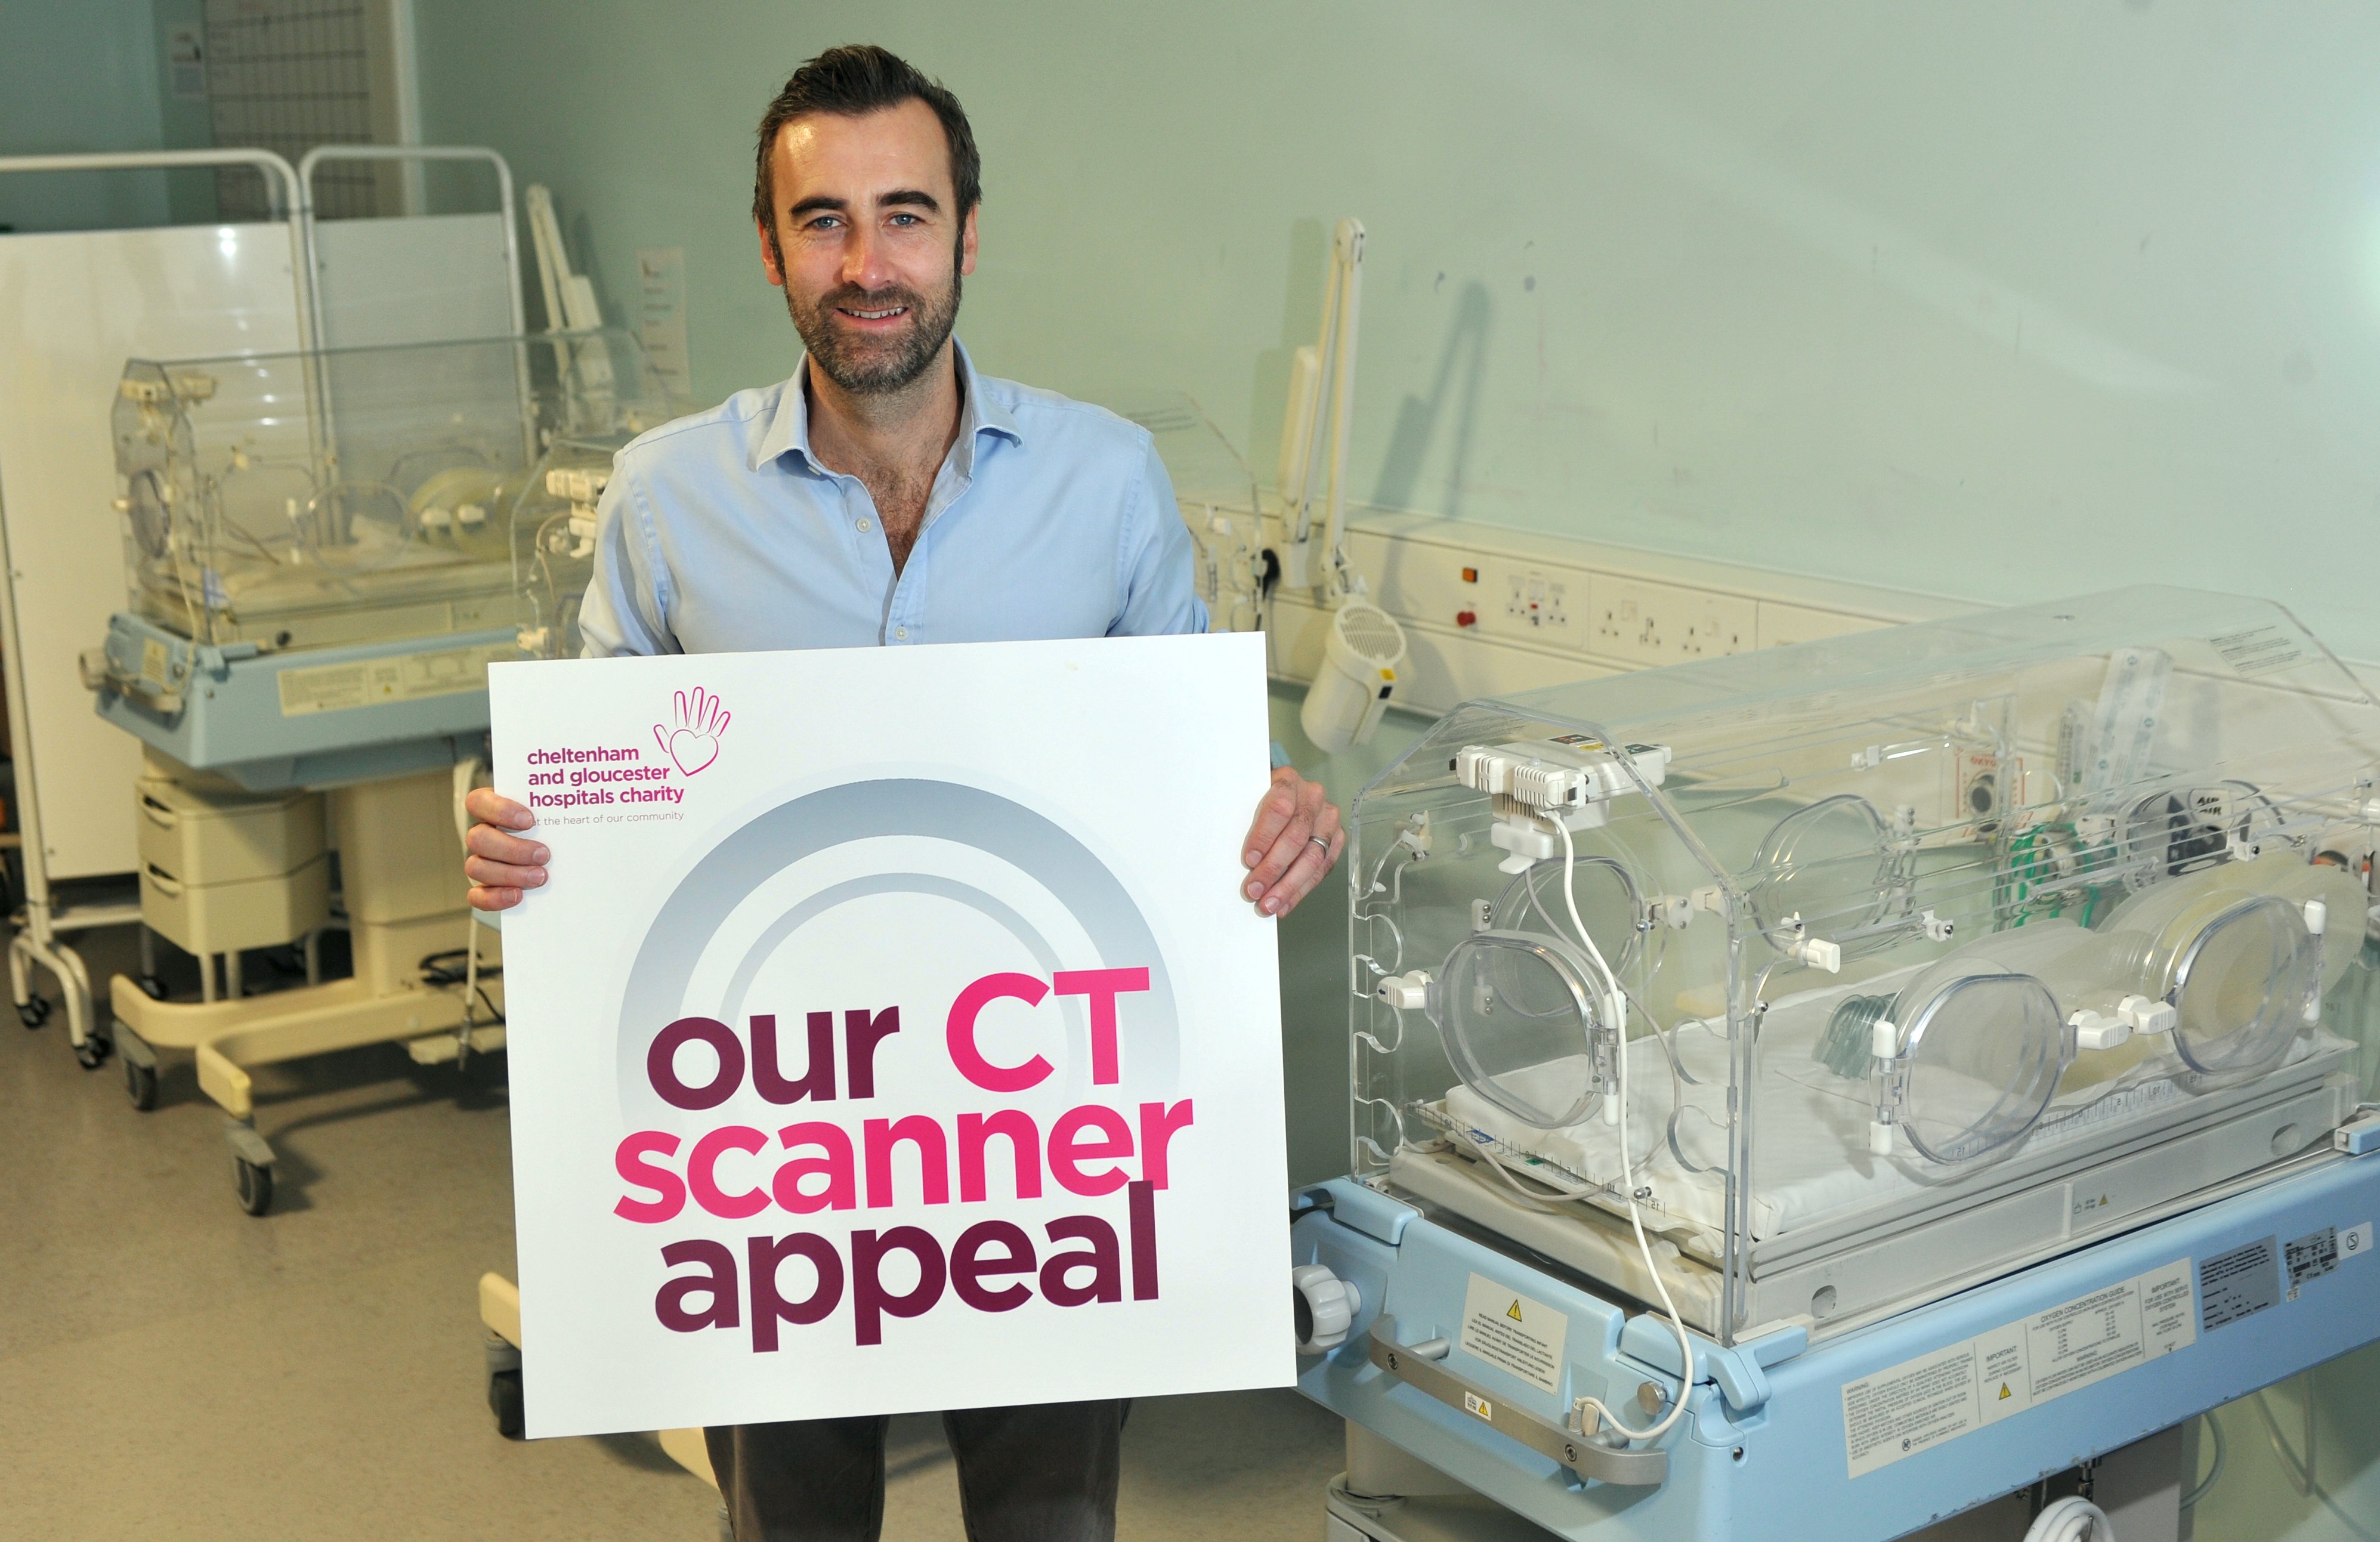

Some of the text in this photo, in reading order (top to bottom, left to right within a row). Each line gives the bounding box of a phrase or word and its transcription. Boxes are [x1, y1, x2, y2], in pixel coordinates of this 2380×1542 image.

[527, 746, 639, 764] cheltenham
[528, 766, 670, 787] and gloucester
[529, 787, 685, 809] hospitals charity
[544, 817, 561, 826] the
[563, 815, 591, 825] heart
[593, 814, 604, 823] of
[626, 811, 685, 822] community
[647, 966, 1150, 1111] our CT
[613, 1098, 1194, 1224] scanner
[654, 1179, 1159, 1353] appeal
